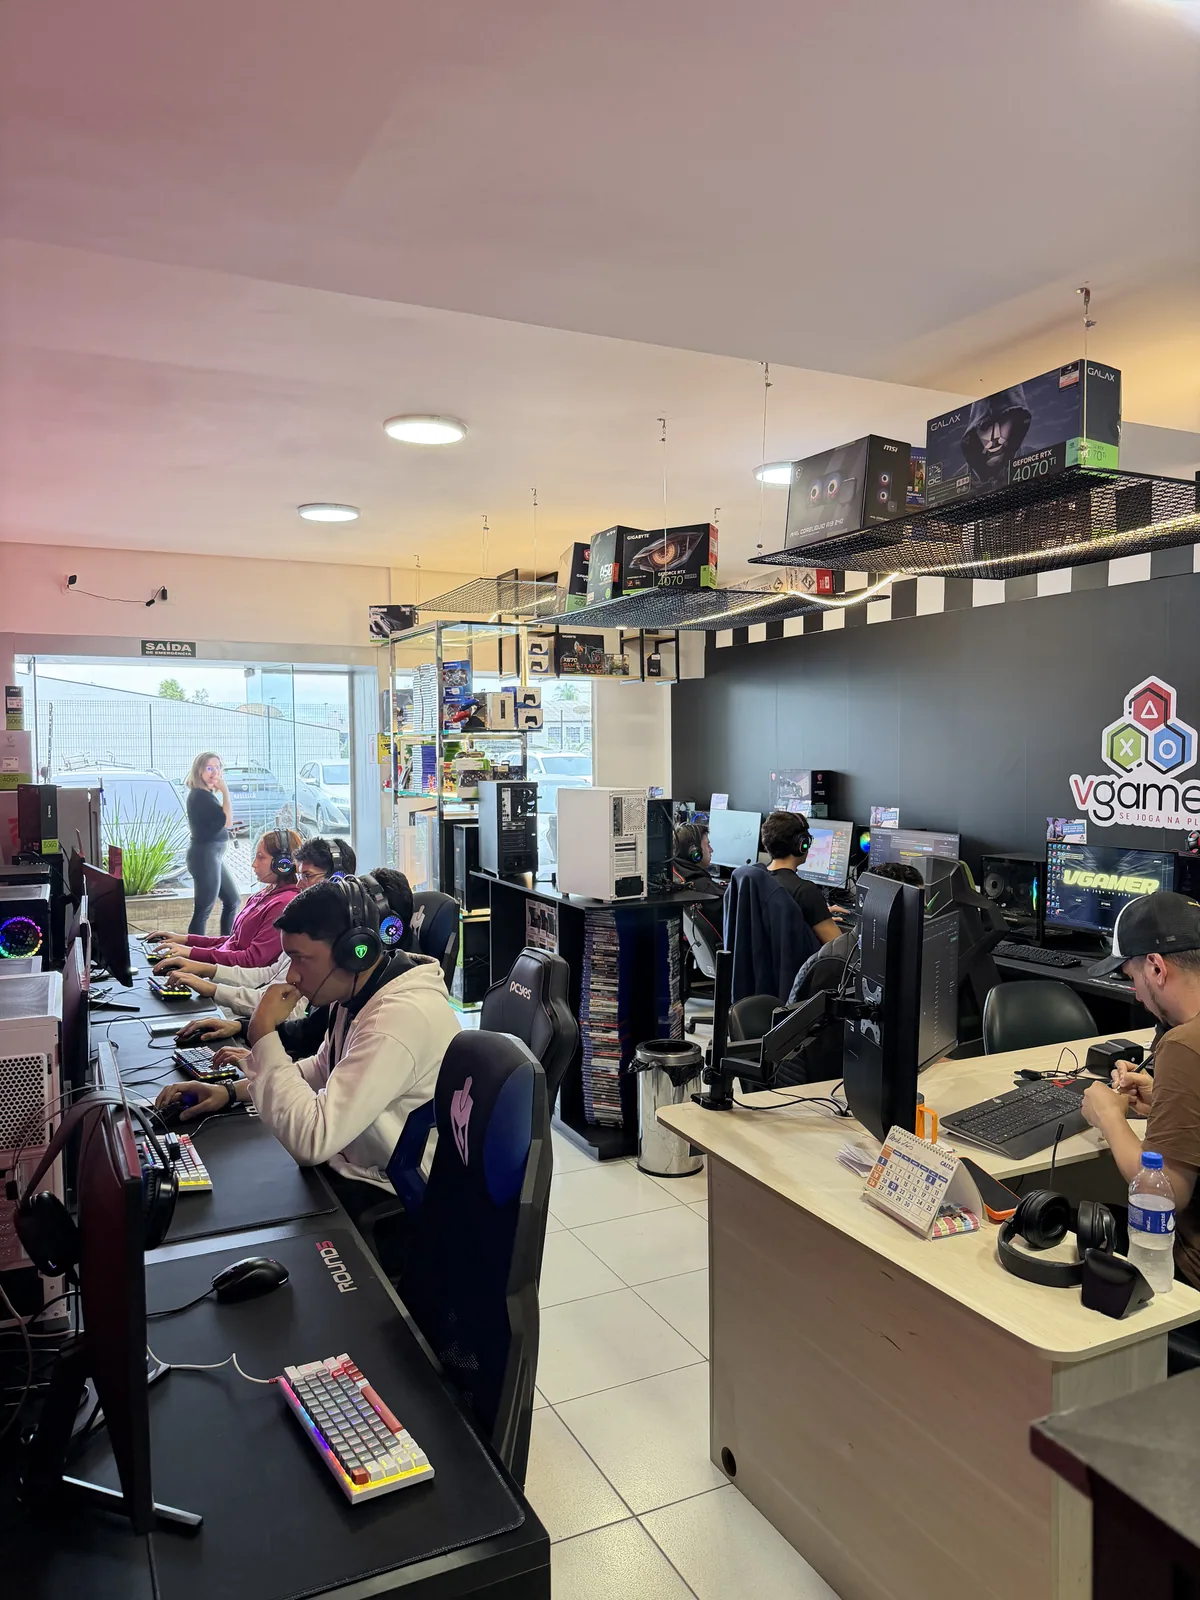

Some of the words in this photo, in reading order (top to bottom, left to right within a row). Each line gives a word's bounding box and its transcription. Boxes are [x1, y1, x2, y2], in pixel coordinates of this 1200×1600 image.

[1088, 368, 1114, 382] GALAX
[930, 414, 960, 431] GALAX
[1013, 452, 1039, 467] GEFORCE
[1040, 449, 1052, 460] RTX
[658, 575, 684, 586] 4070
[145, 642, 192, 651] SAÍDA
[1136, 813, 1160, 822] JOGA
[510, 980, 532, 1000] pcyes
